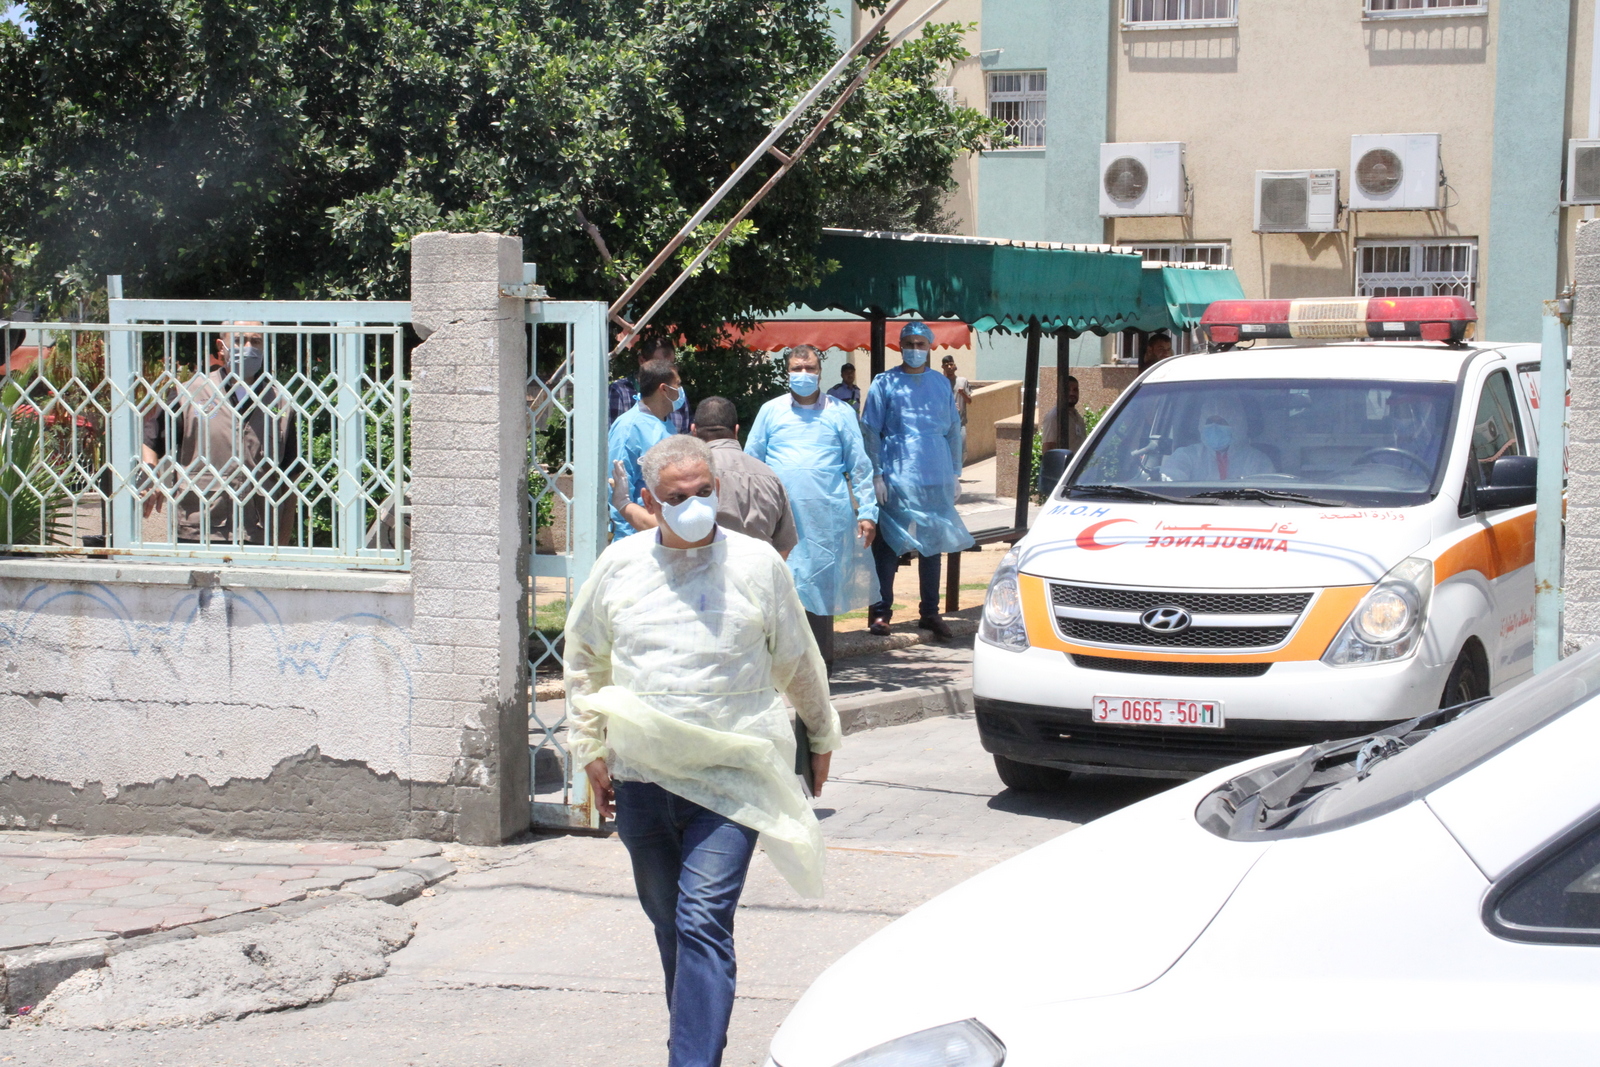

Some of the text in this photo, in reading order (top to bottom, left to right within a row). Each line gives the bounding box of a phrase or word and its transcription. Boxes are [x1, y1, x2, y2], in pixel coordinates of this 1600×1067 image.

[1046, 504, 1111, 518] M.O.H
[1318, 510, 1405, 521] وزارة الصحة
